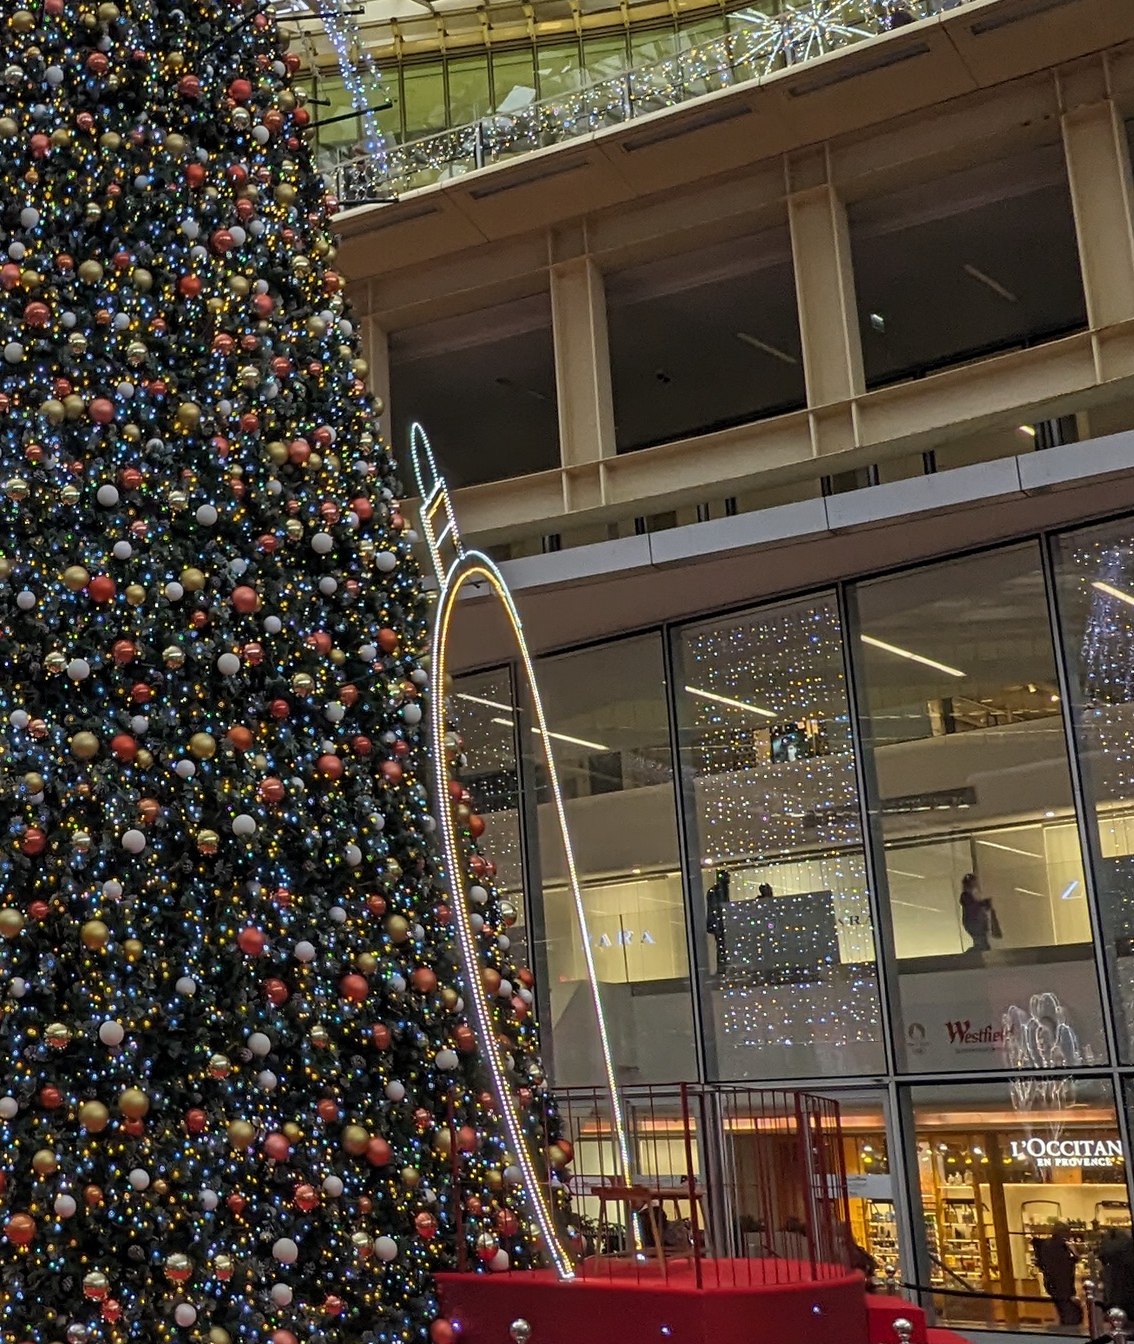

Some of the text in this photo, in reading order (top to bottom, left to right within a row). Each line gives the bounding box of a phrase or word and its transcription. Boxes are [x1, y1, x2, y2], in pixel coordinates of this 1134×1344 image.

[1010, 1138, 1123, 1157] L'OCCITAN
[1036, 1158, 1114, 1167] EN PROVENCE
